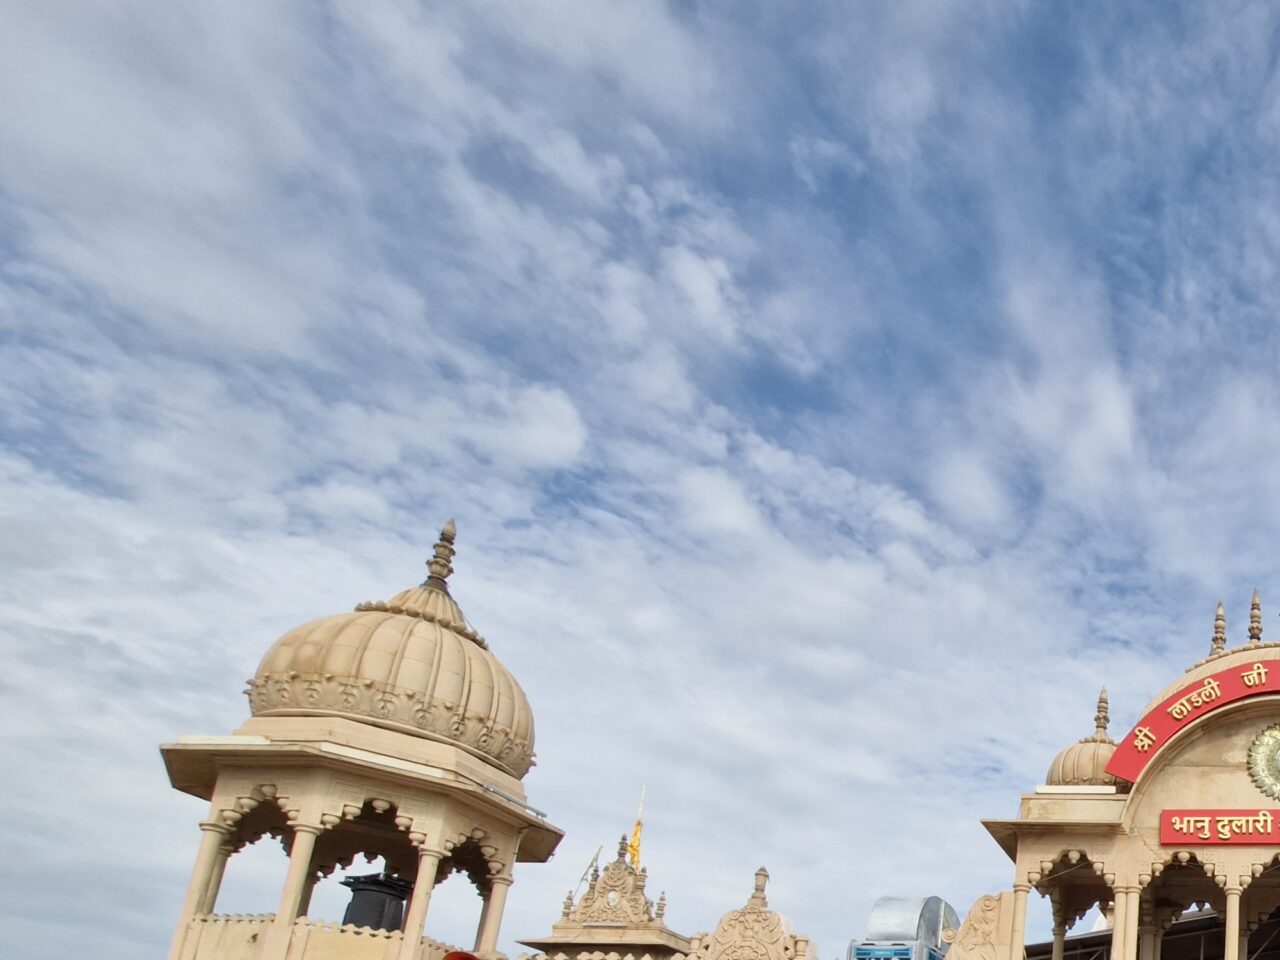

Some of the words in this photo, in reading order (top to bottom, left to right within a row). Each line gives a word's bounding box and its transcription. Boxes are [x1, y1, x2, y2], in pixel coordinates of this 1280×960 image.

[1133, 726, 1156, 751] श्री
[1167, 678, 1221, 719] लाडली
[1241, 663, 1269, 687] जी
[1171, 816, 1211, 839] भानु
[1216, 811, 1274, 839] दुलारी
